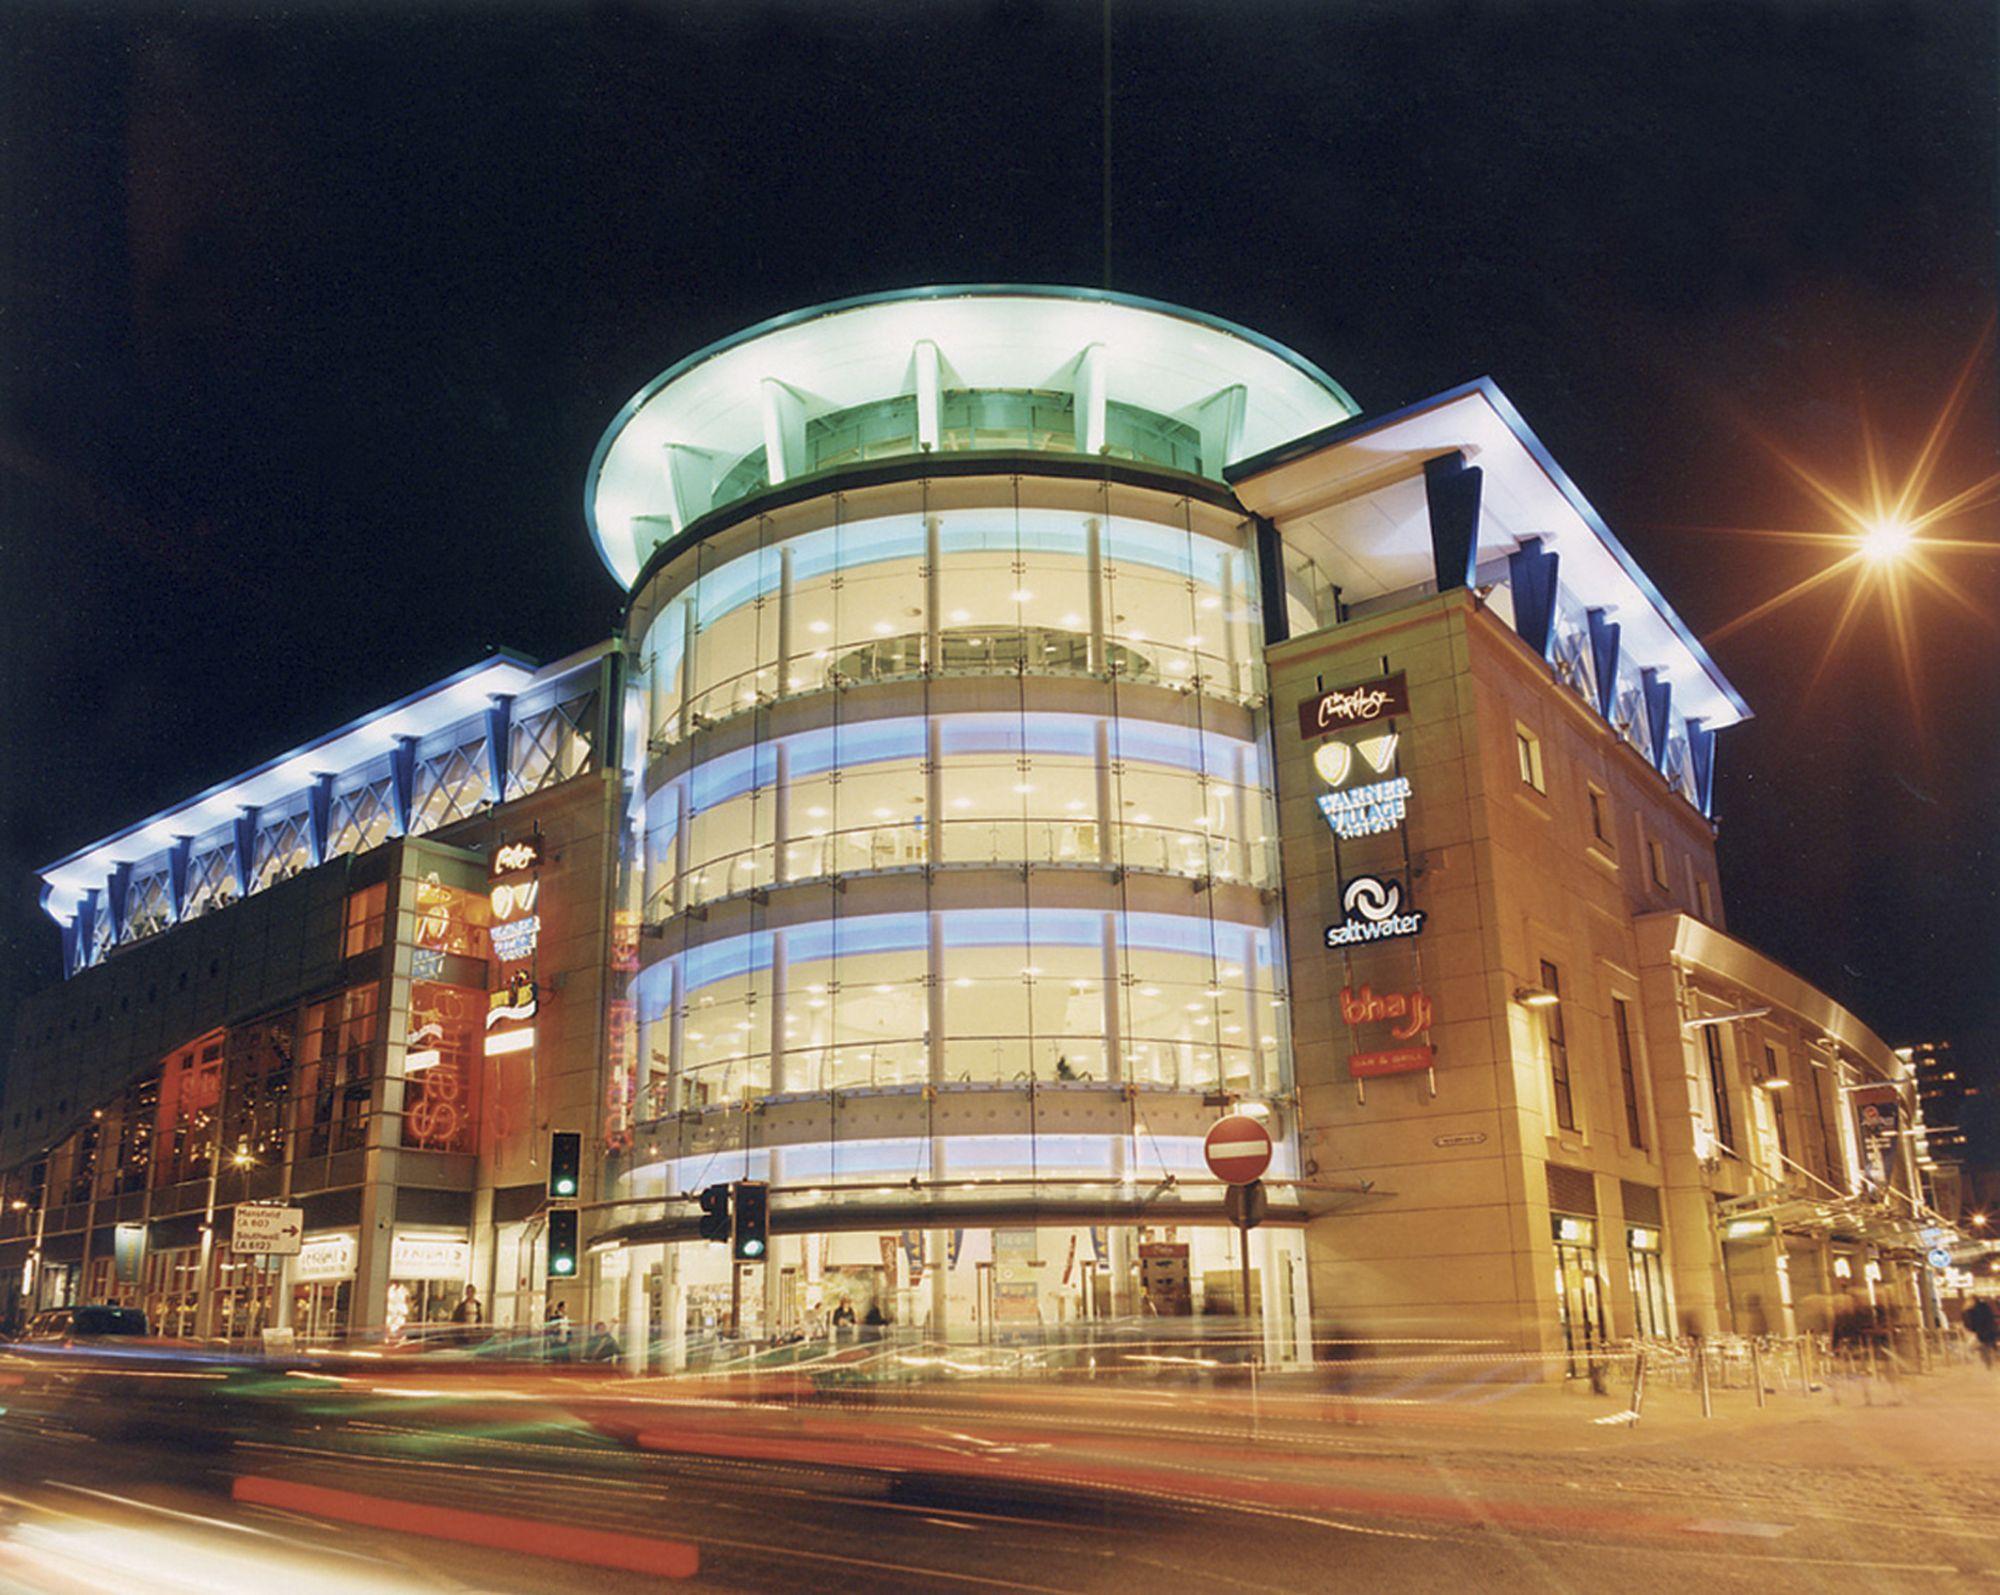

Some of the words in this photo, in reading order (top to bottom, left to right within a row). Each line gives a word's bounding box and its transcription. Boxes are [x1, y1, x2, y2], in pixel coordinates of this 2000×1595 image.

[1328, 797, 1406, 832] VILLAGE
[1328, 913, 1421, 946] saltwater
[1340, 983, 1433, 1040] bhaji
[238, 1209, 281, 1218] Mansfield
[237, 1231, 280, 1240] Southwell
